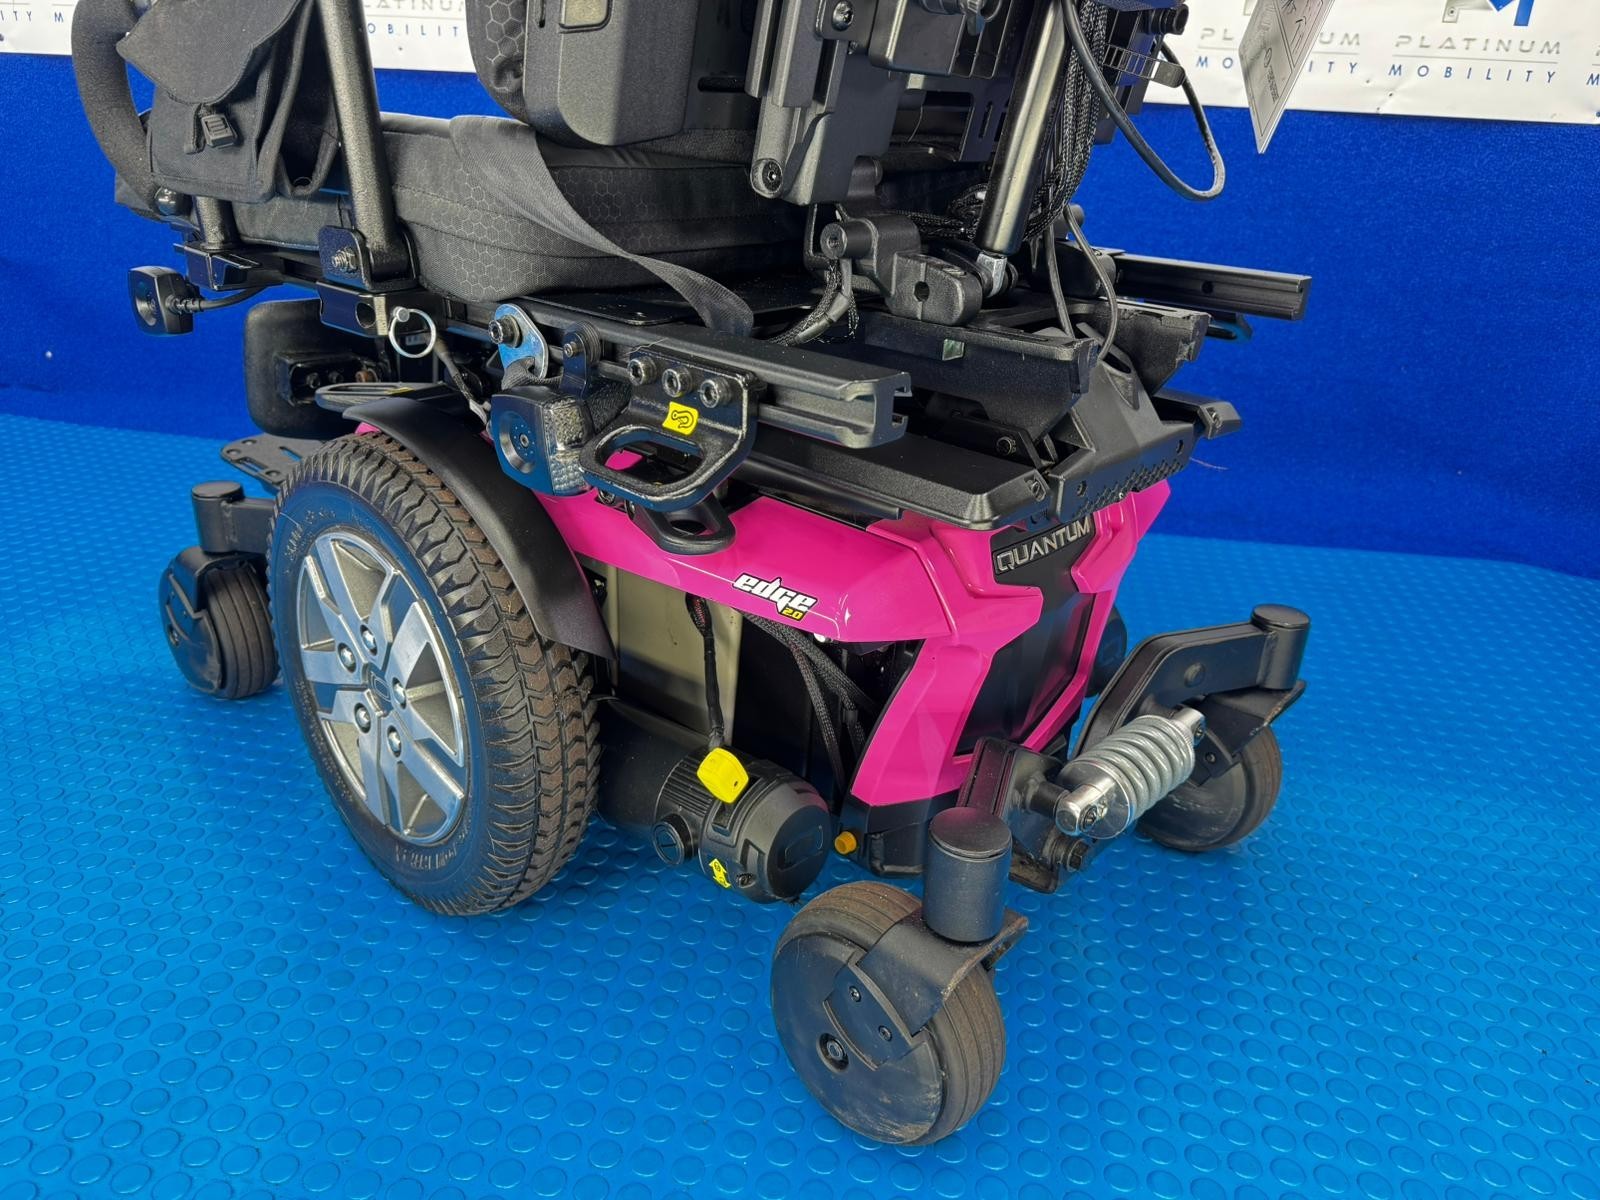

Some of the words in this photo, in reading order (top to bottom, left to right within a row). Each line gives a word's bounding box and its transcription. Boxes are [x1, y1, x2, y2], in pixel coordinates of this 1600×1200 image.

[367, 22, 459, 37] OBILIT
[1395, 35, 1560, 55] PLATINUM
[1388, 64, 1556, 83] MOBILITY
[996, 515, 1092, 571] QUANTUM
[733, 573, 817, 613] edge
